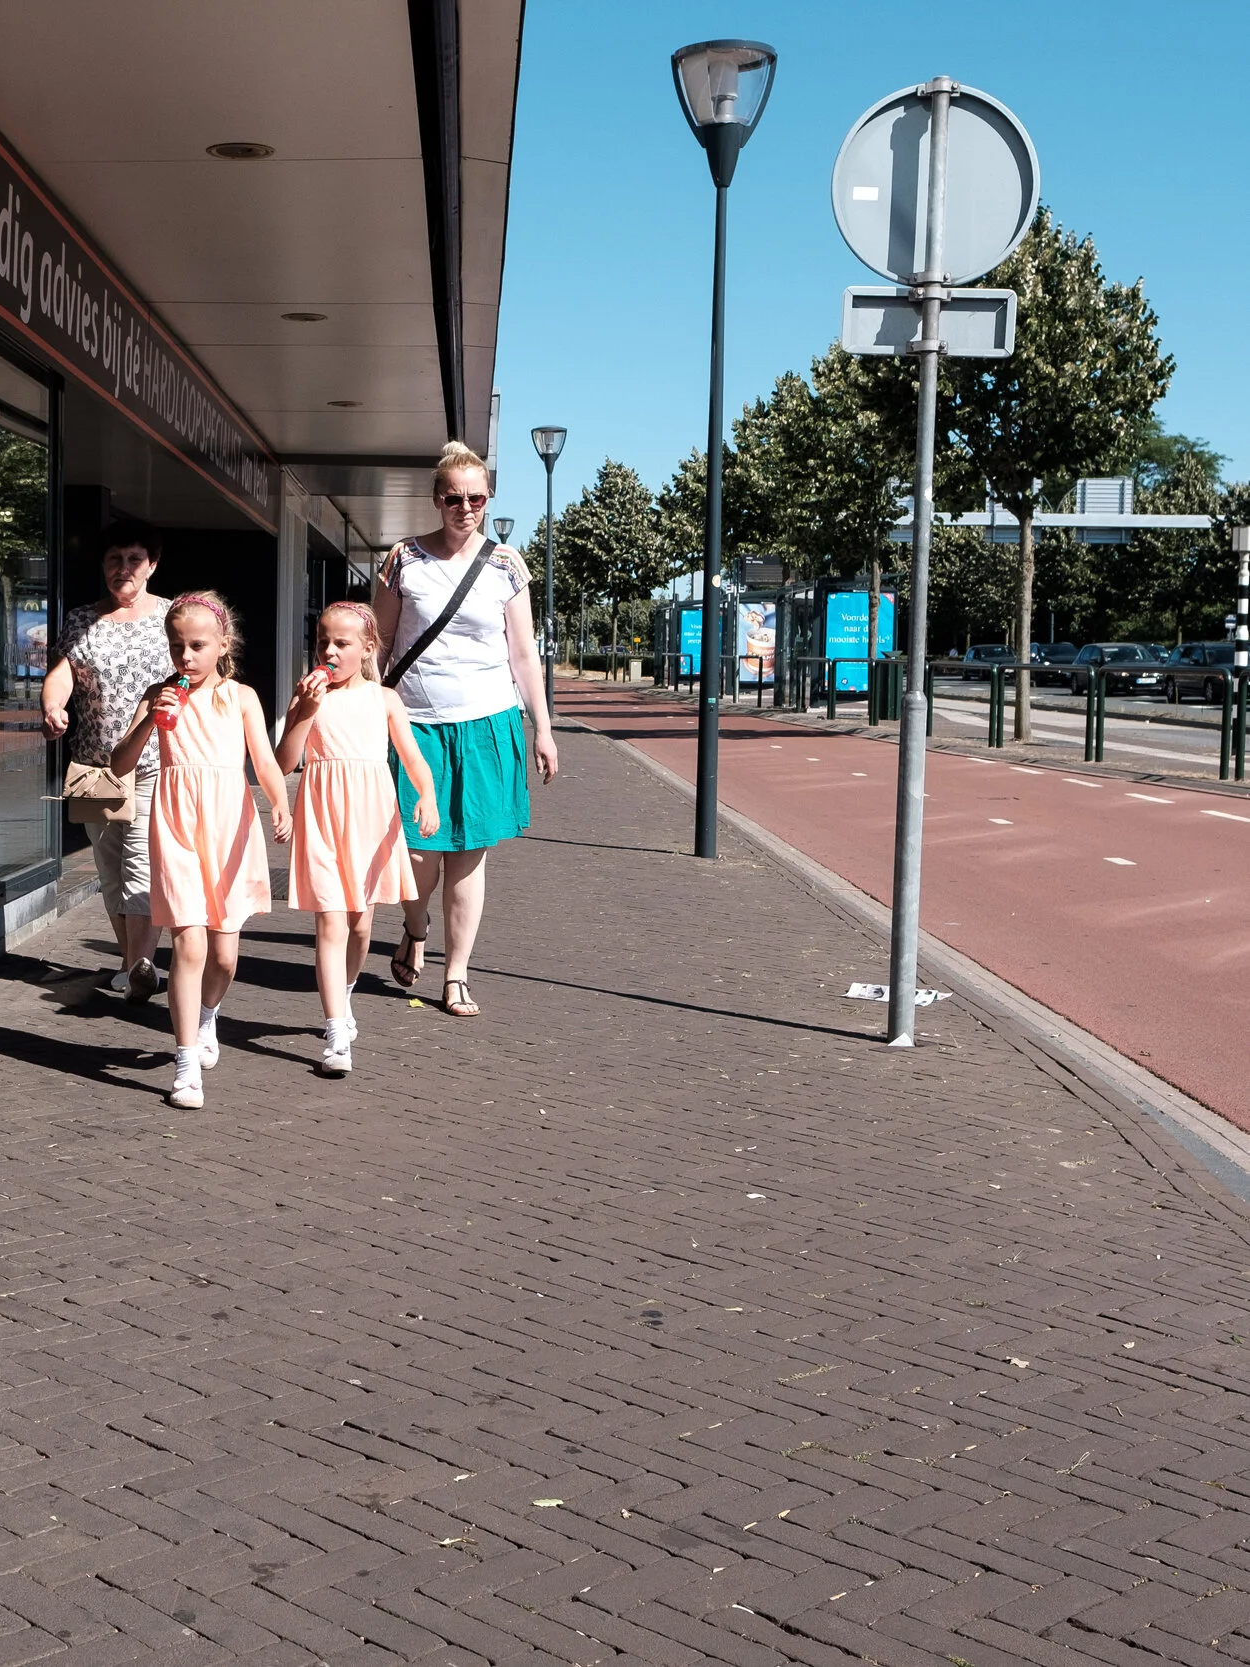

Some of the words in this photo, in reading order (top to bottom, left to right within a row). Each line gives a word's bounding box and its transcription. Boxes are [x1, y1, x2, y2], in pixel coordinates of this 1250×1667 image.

[39, 242, 99, 358] advies
[102, 289, 122, 398] bij
[124, 317, 141, 396] dé
[142, 335, 242, 483] HARDLOOPSPECIALIST
[841, 613, 869, 622] Voorde
